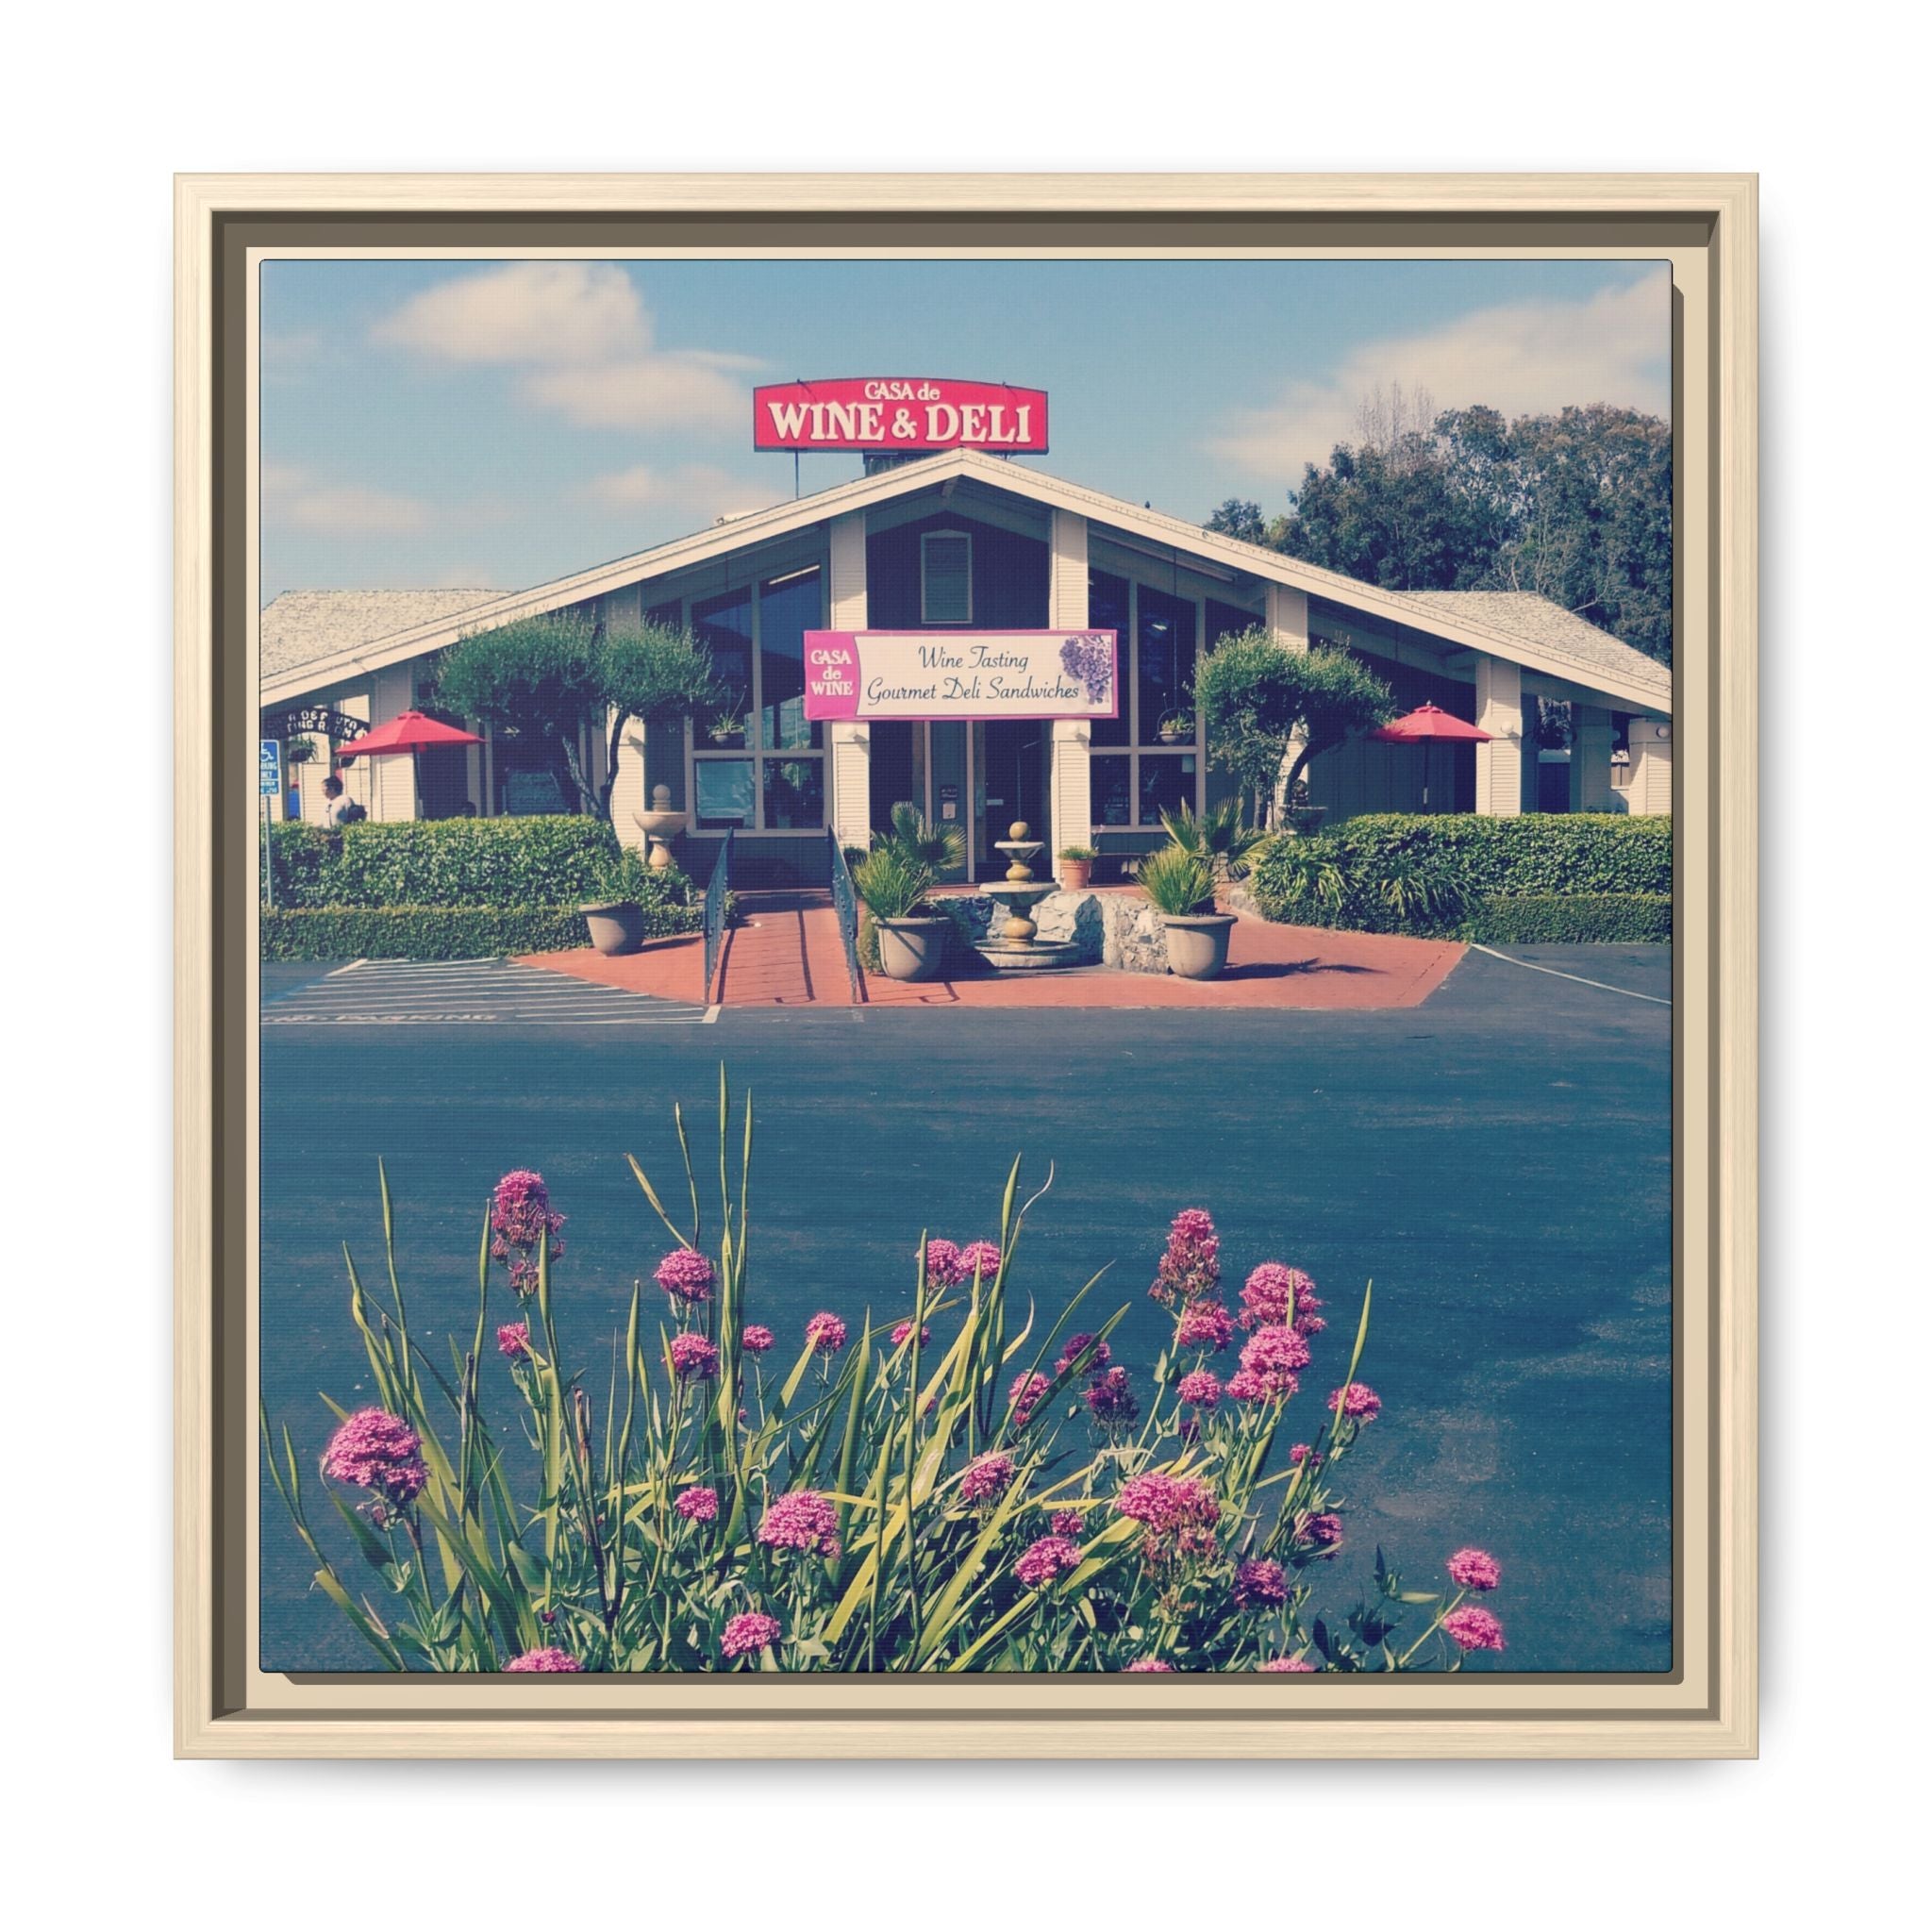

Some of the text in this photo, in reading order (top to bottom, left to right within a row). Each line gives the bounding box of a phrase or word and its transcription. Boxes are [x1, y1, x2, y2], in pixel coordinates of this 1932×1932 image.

[864, 382, 941, 401] CASA de
[768, 401, 1032, 443] WINE & DELI
[810, 649, 853, 665] CASA
[918, 645, 1029, 674] Wine Tasting
[823, 665, 842, 680] de
[810, 680, 854, 696] WINE
[867, 675, 1079, 707] Gourmet Deli Sandwiches
